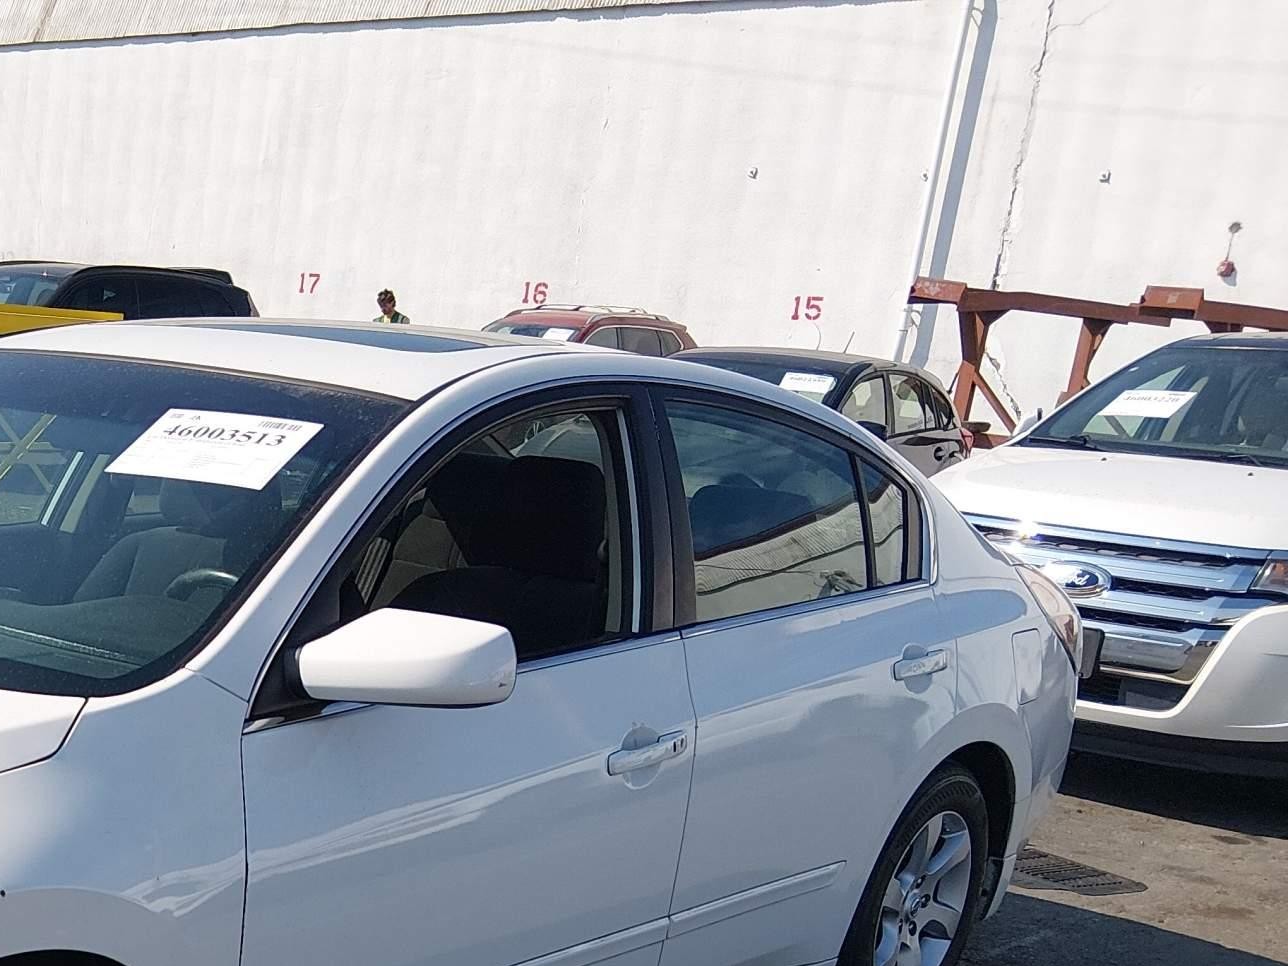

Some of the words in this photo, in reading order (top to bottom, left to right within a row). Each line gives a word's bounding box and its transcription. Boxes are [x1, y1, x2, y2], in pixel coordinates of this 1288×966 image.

[299, 273, 320, 293] 17
[521, 282, 549, 304] 16
[791, 296, 824, 320] 15
[163, 424, 287, 446] 46003513
